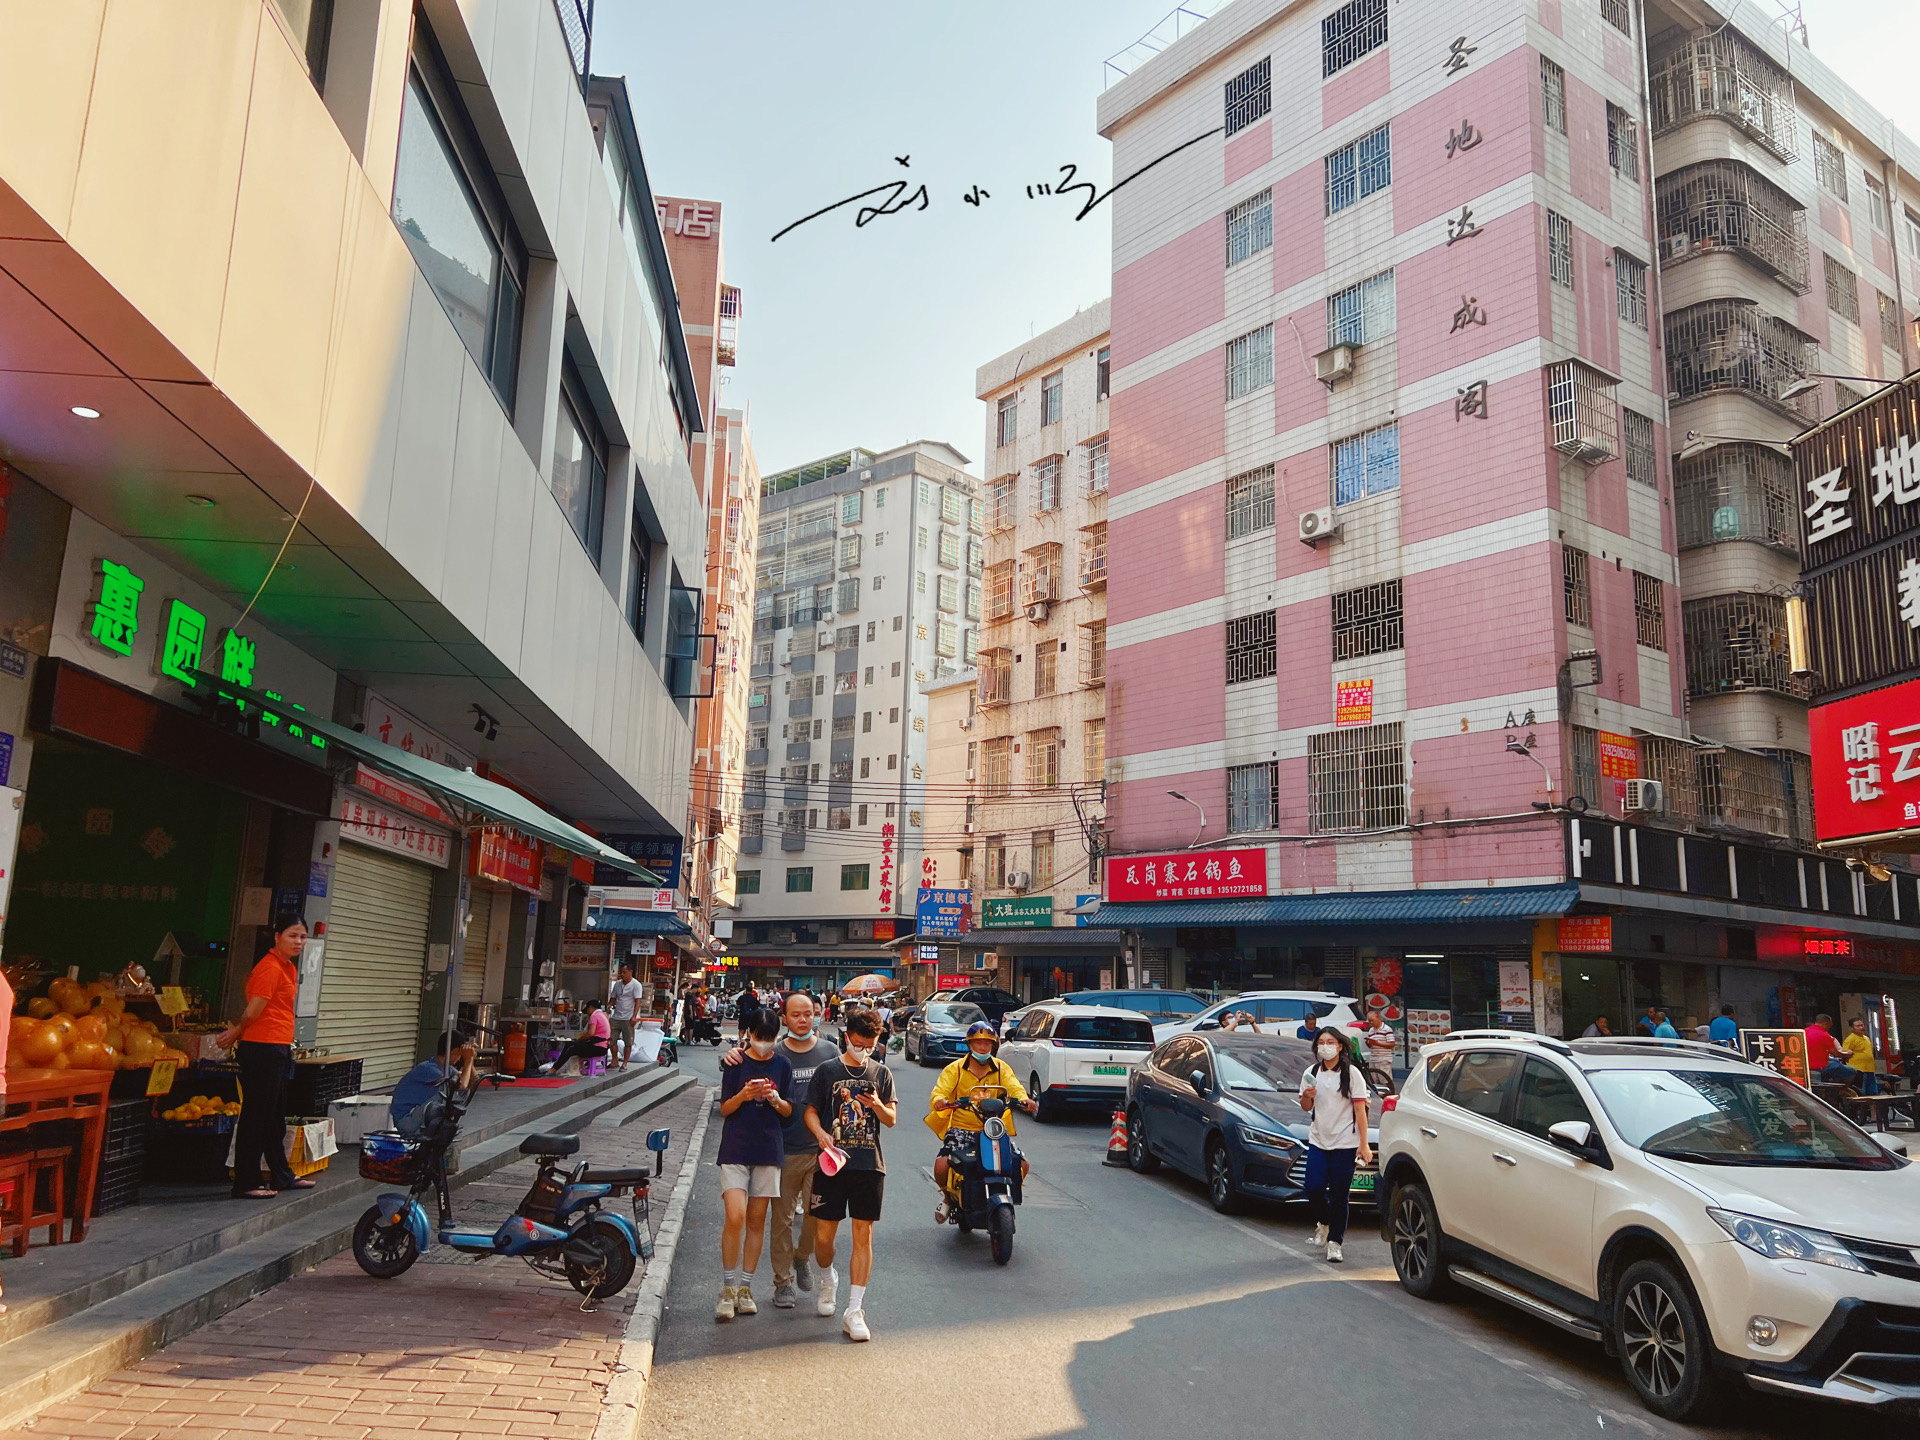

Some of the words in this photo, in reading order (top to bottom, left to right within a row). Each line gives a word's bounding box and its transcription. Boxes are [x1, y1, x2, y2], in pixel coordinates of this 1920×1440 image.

[1442, 35, 1489, 422] 圣地达成阁
[1503, 707, 1538, 730] A座
[1842, 722, 1884, 803] 昭记
[1903, 801, 1920, 820] 鱼
[1125, 856, 1244, 887] 瓦岗寨石锅鱼
[653, 890, 672, 903] 酒
[1217, 884, 1263, 895] 13512721858
[1804, 939, 1851, 955] 烟酒茶
